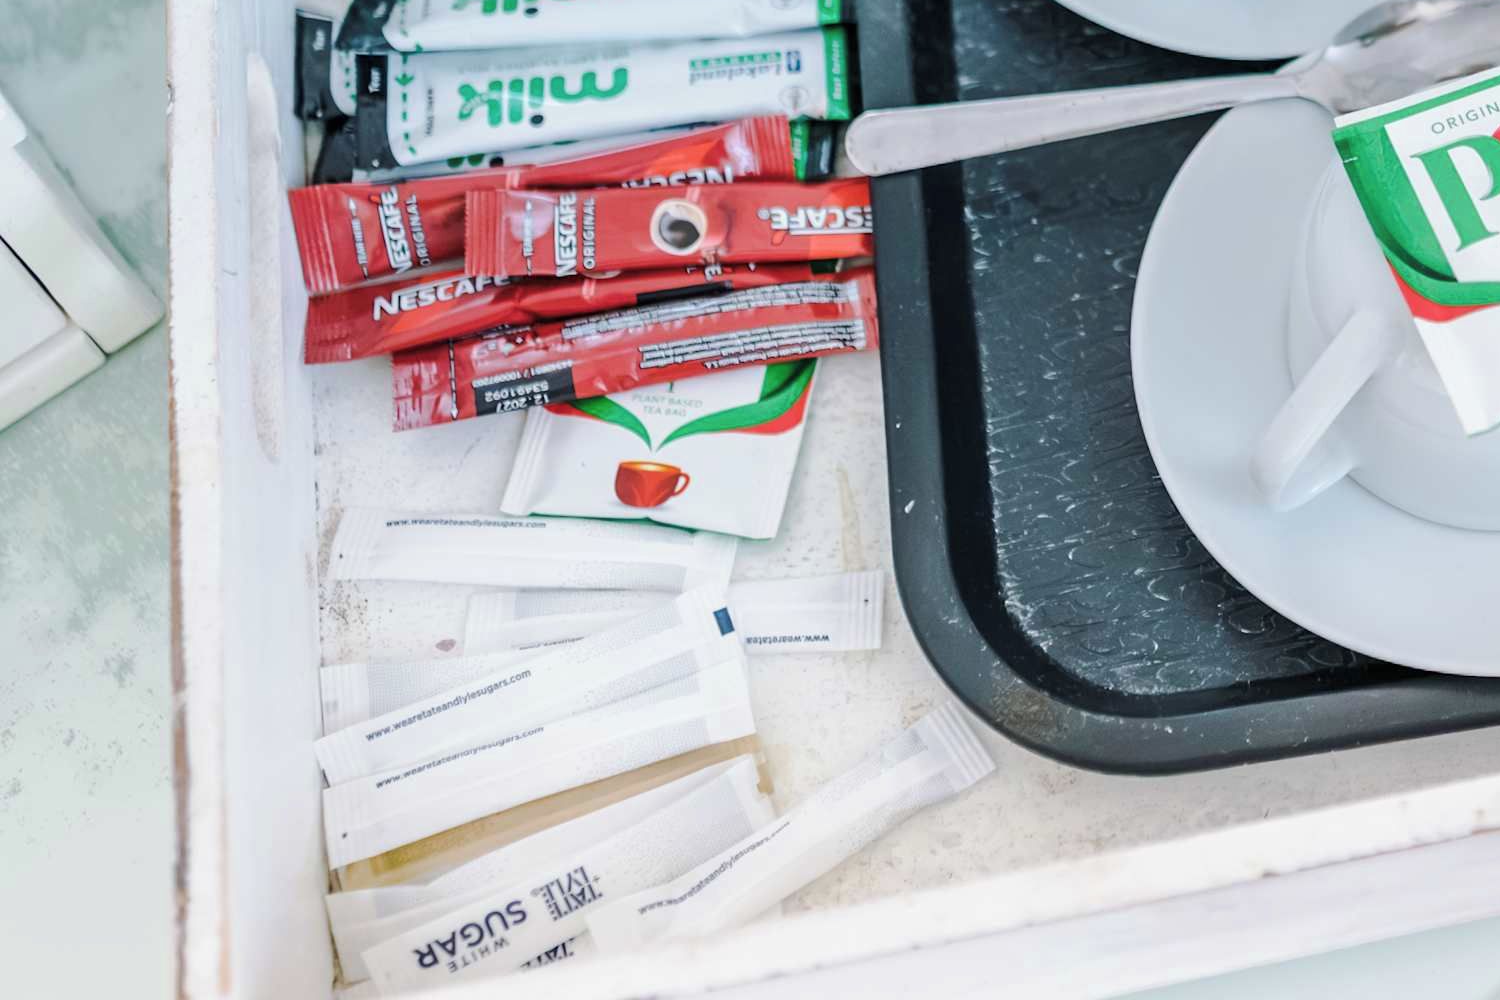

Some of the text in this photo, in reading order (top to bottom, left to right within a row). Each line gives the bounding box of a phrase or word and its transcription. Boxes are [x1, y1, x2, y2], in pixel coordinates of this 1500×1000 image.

[367, 67, 381, 94] Tear
[457, 66, 629, 128] milk
[405, 194, 431, 267] ORIGINAL
[582, 197, 596, 270] ORIGINAL
[496, 393, 549, 414] 12.2027
[365, 668, 532, 742] www.wearetateandlylesugars.com
[550, 884, 603, 921] TATE
[413, 900, 528, 969] SUGAR
[448, 937, 510, 973] WHITE
